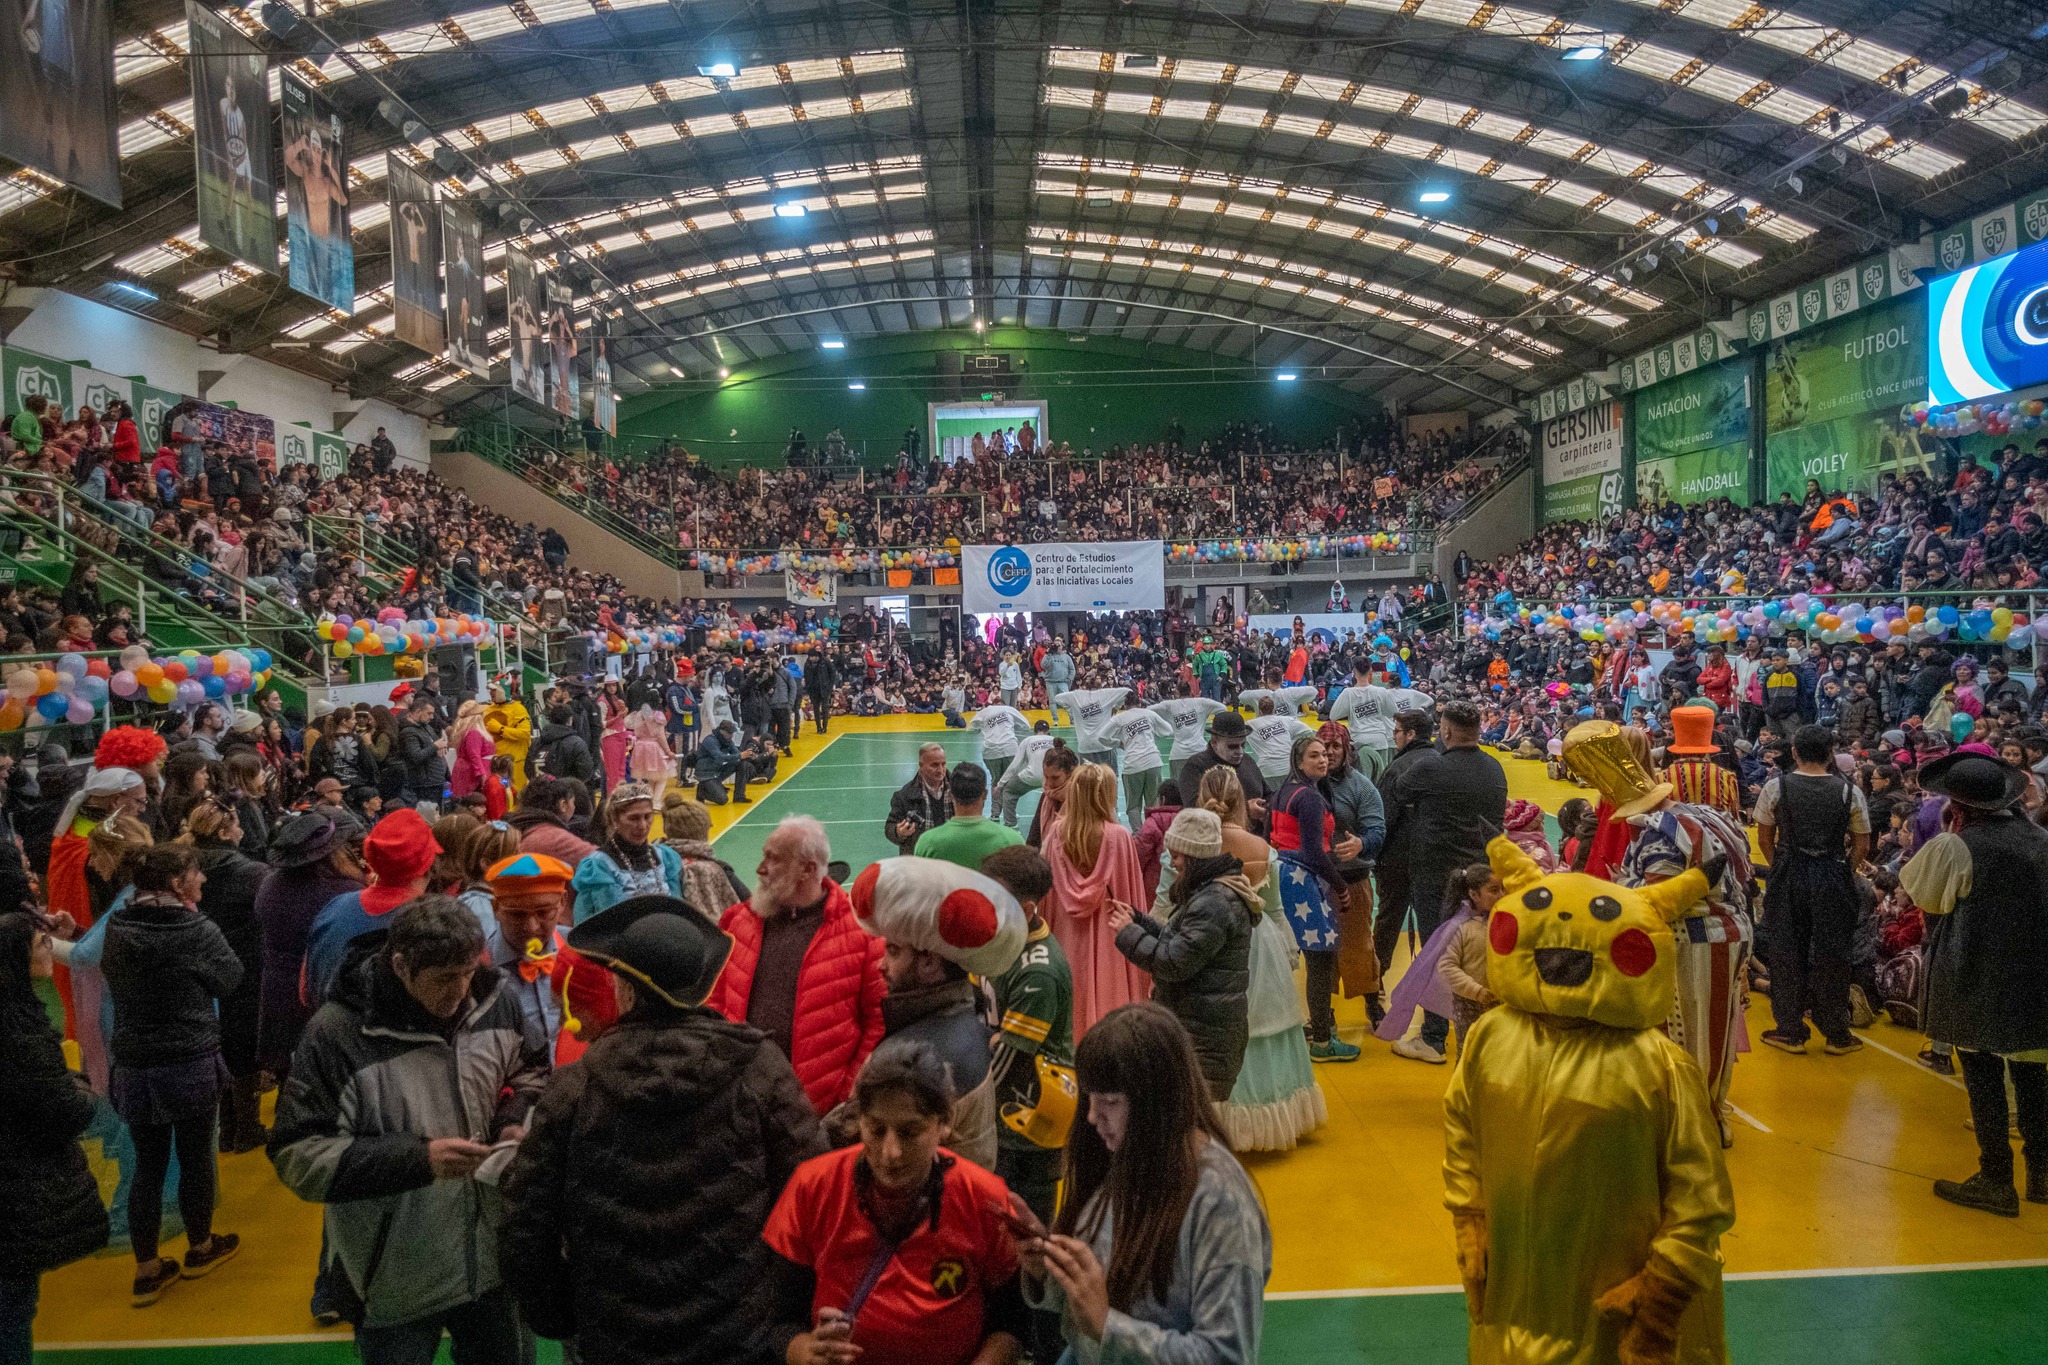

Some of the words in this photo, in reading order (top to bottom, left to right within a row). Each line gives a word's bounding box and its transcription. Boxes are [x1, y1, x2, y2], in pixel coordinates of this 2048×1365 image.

[1844, 325, 1909, 362] FUTBOL
[1818, 399, 1837, 411] CLUB
[1876, 382, 1900, 397] ONCE
[1648, 393, 1701, 421] NATACIÓN
[1547, 402, 1611, 449] GERSINI
[1559, 437, 1612, 463] carpinteria
[1802, 452, 1848, 477] VOLEY
[1681, 471, 1741, 496] HANDBALL
[1548, 506, 1566, 518] CENTRO
[1567, 502, 1592, 516] CULTURAL
[1035, 553, 1064, 563] Centro
[1066, 553, 1077, 563] de
[1079, 553, 1116, 563] Estudios
[1035, 566, 1054, 577] para
[1056, 565, 1064, 574] el
[1066, 564, 1134, 575] Fortalecimiento
[1042, 576, 1055, 586] las
[1056, 576, 1100, 586] Iniciativas
[1101, 576, 1134, 586] Locales
[1354, 702, 1377, 714] dance
[1174, 712, 1196, 723] dance
[1126, 719, 1148, 733] dance
[1259, 722, 1283, 736] dance
